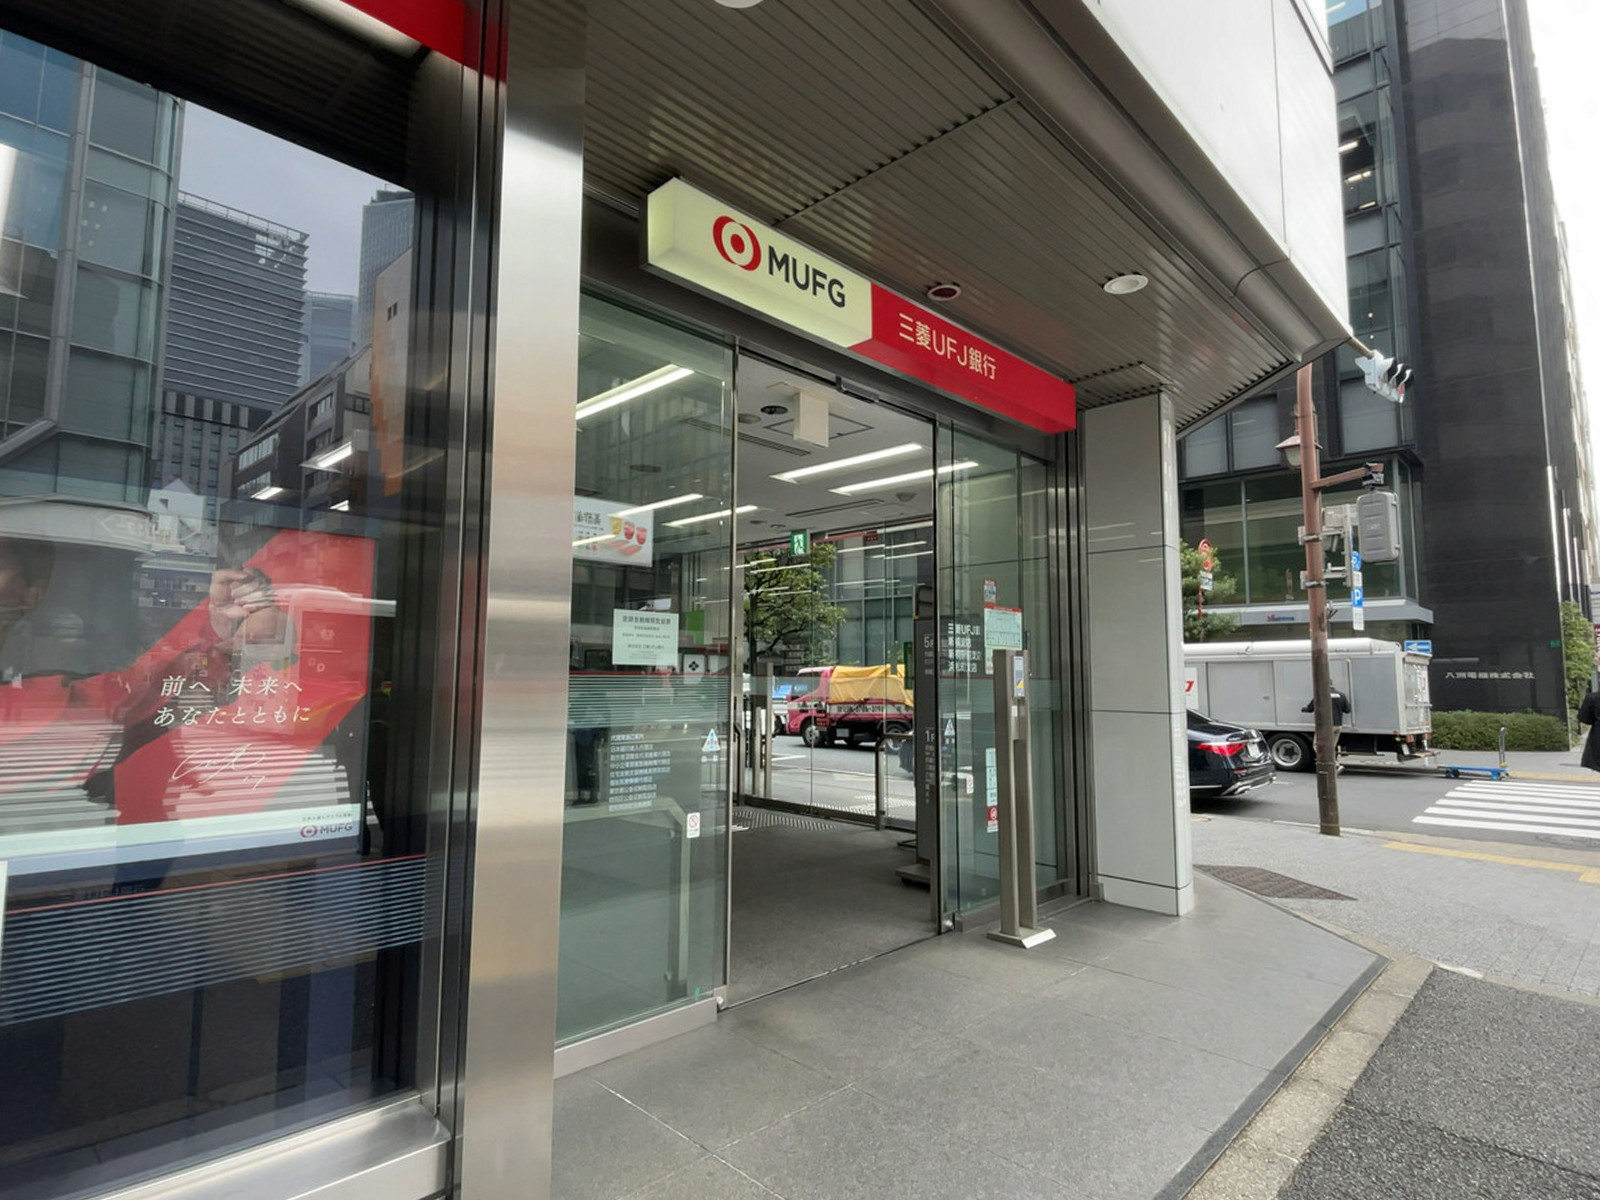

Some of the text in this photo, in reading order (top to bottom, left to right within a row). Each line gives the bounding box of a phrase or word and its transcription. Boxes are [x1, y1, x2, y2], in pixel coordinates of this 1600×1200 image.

[768, 245, 846, 309] MUFG
[898, 312, 996, 381] 三菱UFJ銀行
[160, 675, 303, 697] 前へ 未来へ
[153, 706, 312, 727] あなたとともに
[319, 822, 353, 834] MUFG
